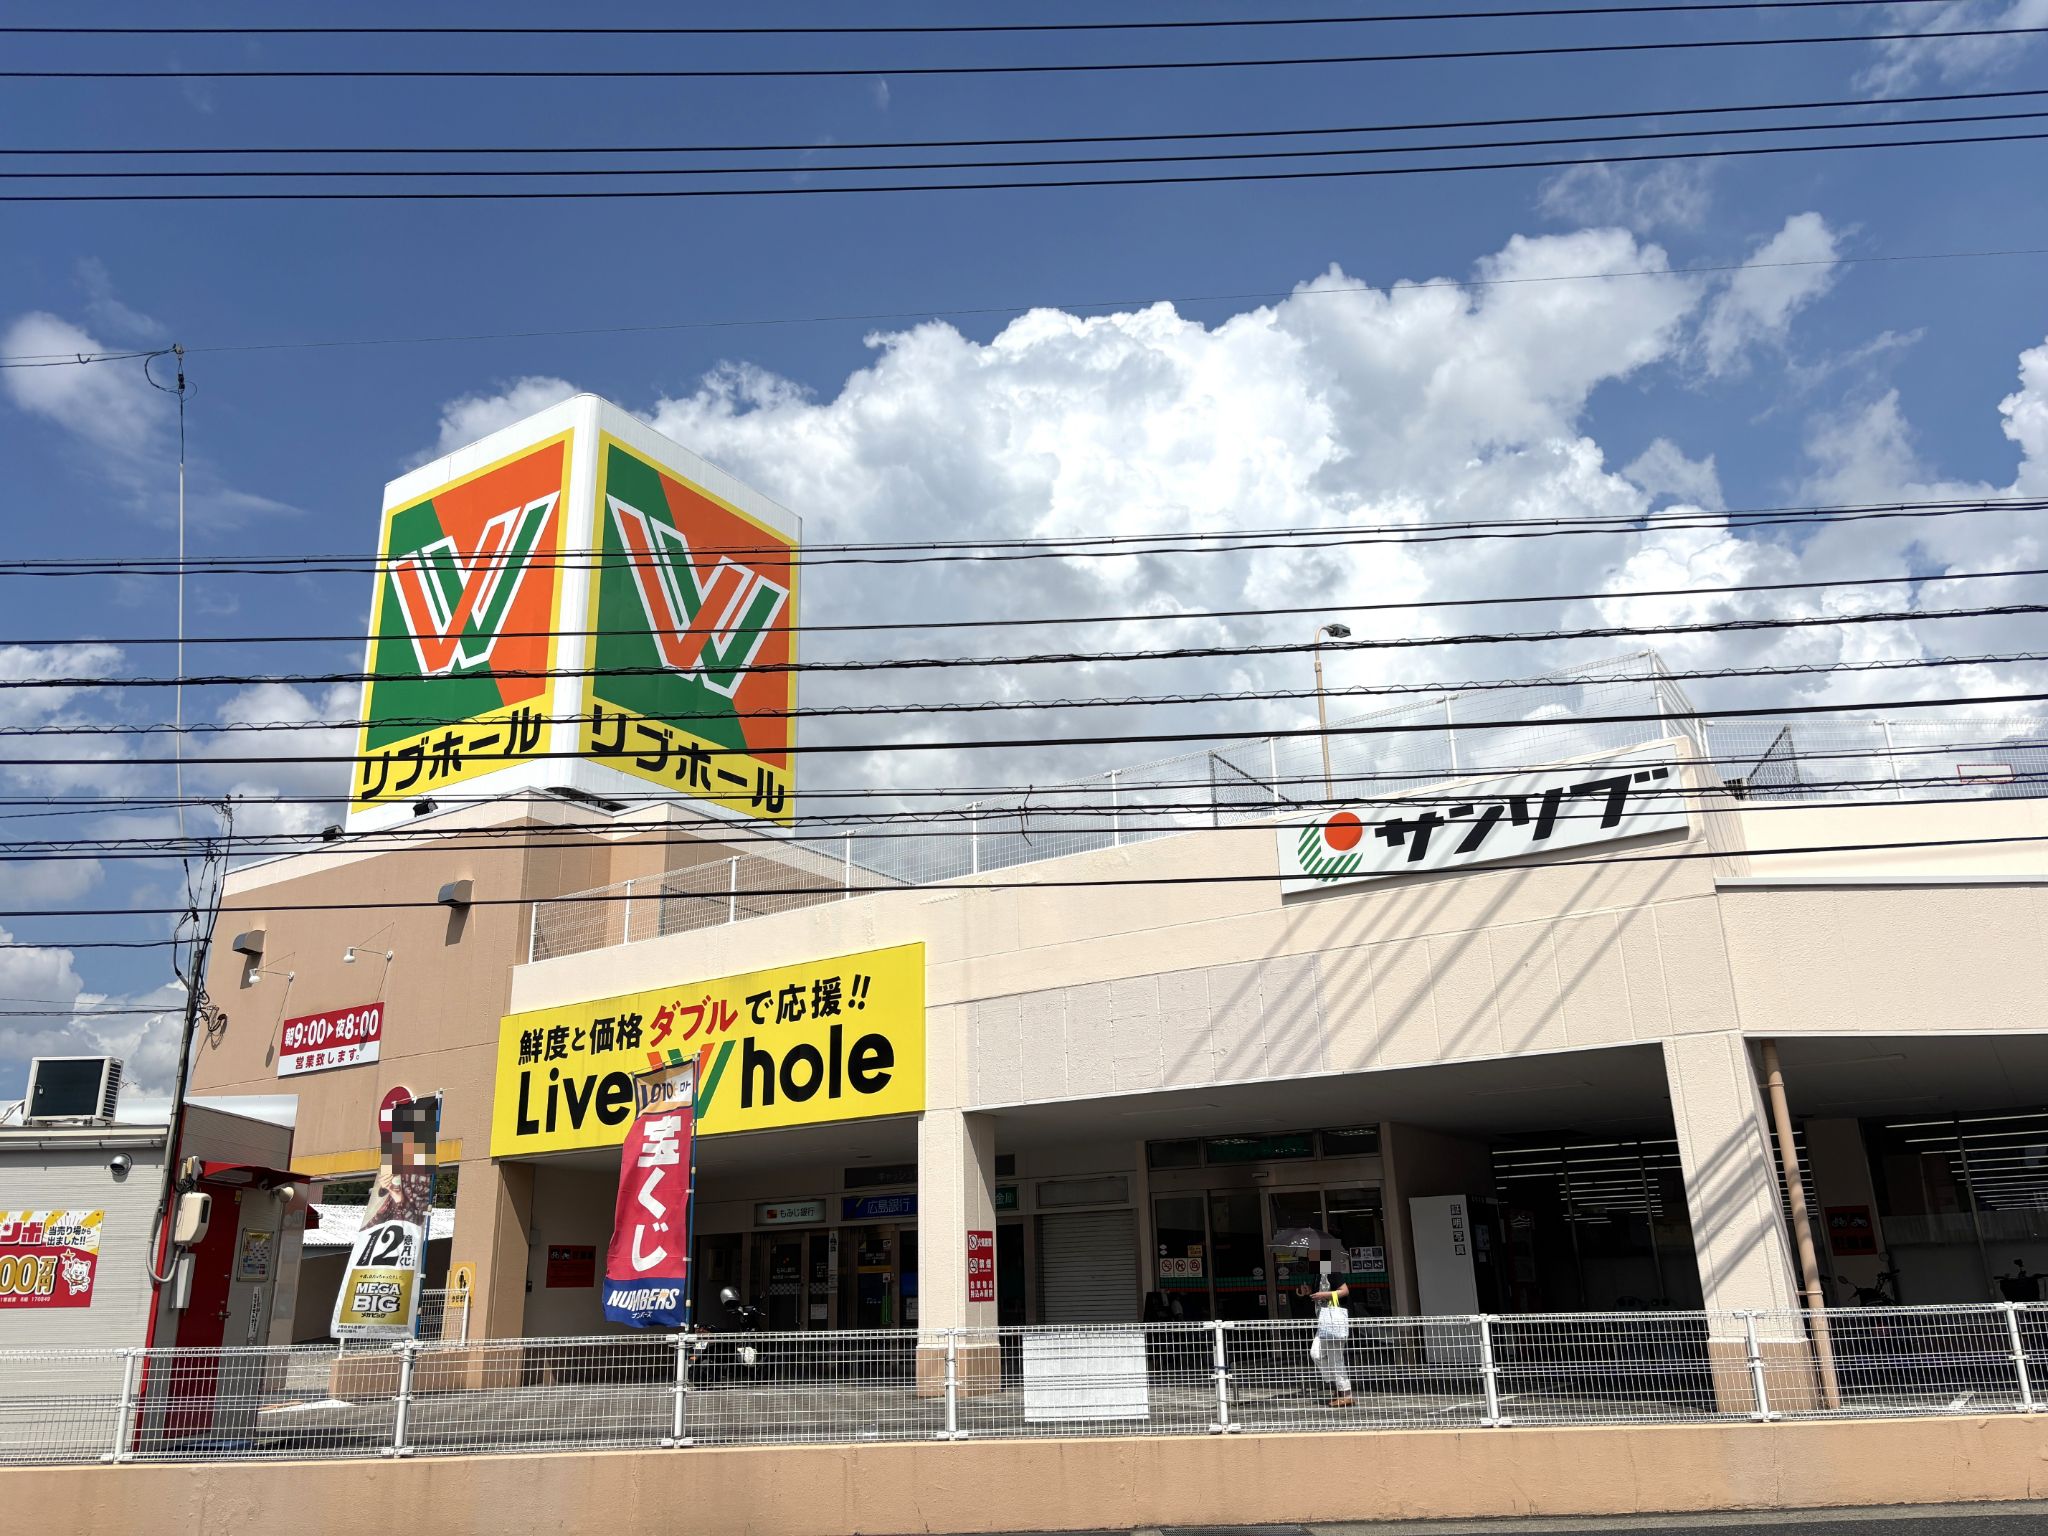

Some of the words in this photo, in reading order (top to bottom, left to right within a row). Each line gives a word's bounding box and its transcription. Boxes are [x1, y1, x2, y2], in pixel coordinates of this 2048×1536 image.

[362, 706, 542, 800] リブホール
[591, 704, 785, 814] リブホール
[1374, 767, 1669, 863] サンリブ
[295, 1048, 360, 1070] 営業致します。
[516, 1067, 634, 1136] Live
[631, 1116, 682, 1272] 宝くじ
[779, 1206, 816, 1219] もみじ銀行
[867, 1198, 910, 1215] 広島銀行
[47, 1236, 87, 1246] 出ました!!
[48, 1226, 92, 1236] 当売り場から
[356, 1224, 404, 1267] 12
[355, 1282, 401, 1296] MEGA
[607, 1288, 681, 1311] NUMBERS
[351, 1295, 399, 1313] BIG
